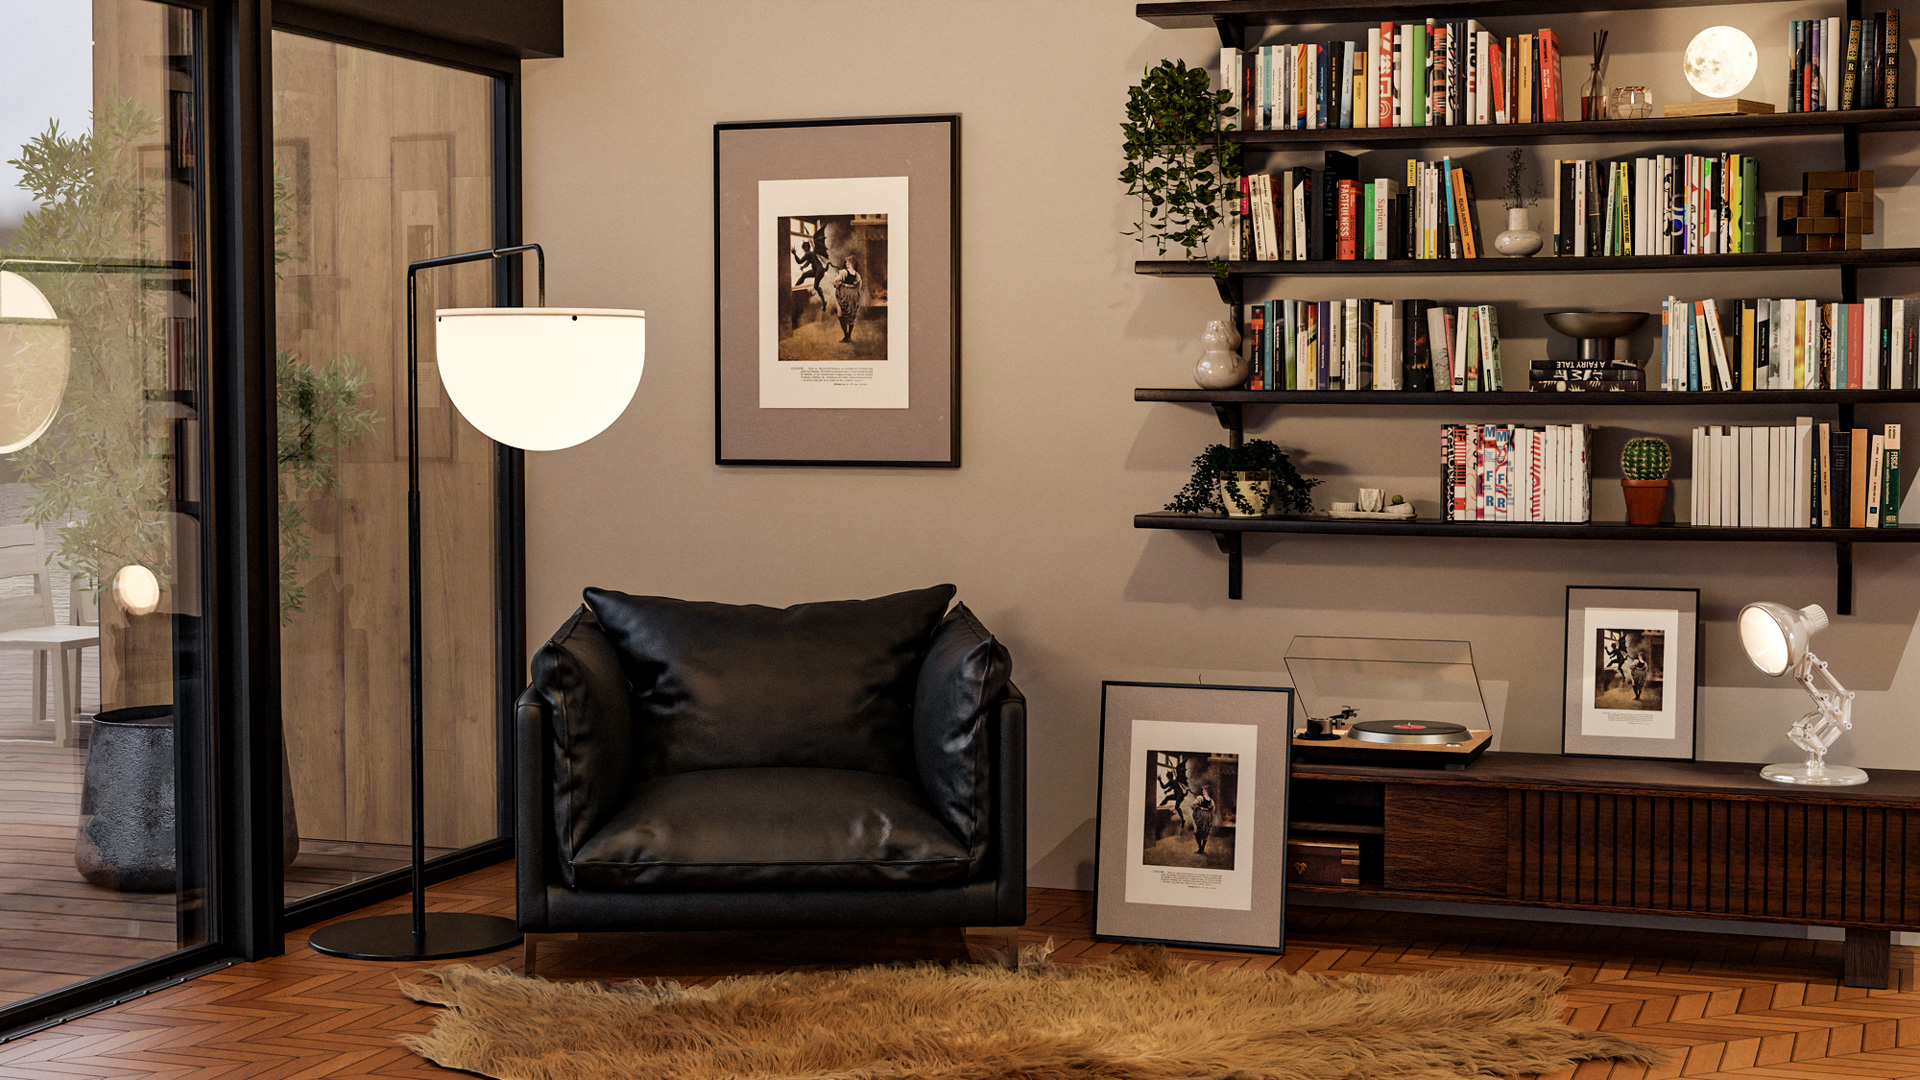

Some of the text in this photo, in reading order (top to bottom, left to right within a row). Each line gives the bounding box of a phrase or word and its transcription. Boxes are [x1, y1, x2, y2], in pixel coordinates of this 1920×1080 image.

[1888, 57, 1895, 65] R
[1340, 184, 1349, 236] FACTFULNESS
[1375, 198, 1386, 232] Sapiens
[1556, 361, 1605, 369] A FAIRY TALE
[1485, 426, 1496, 507] M F R
[1496, 431, 1506, 508] M F R
[1890, 451, 1898, 470] FISICA
